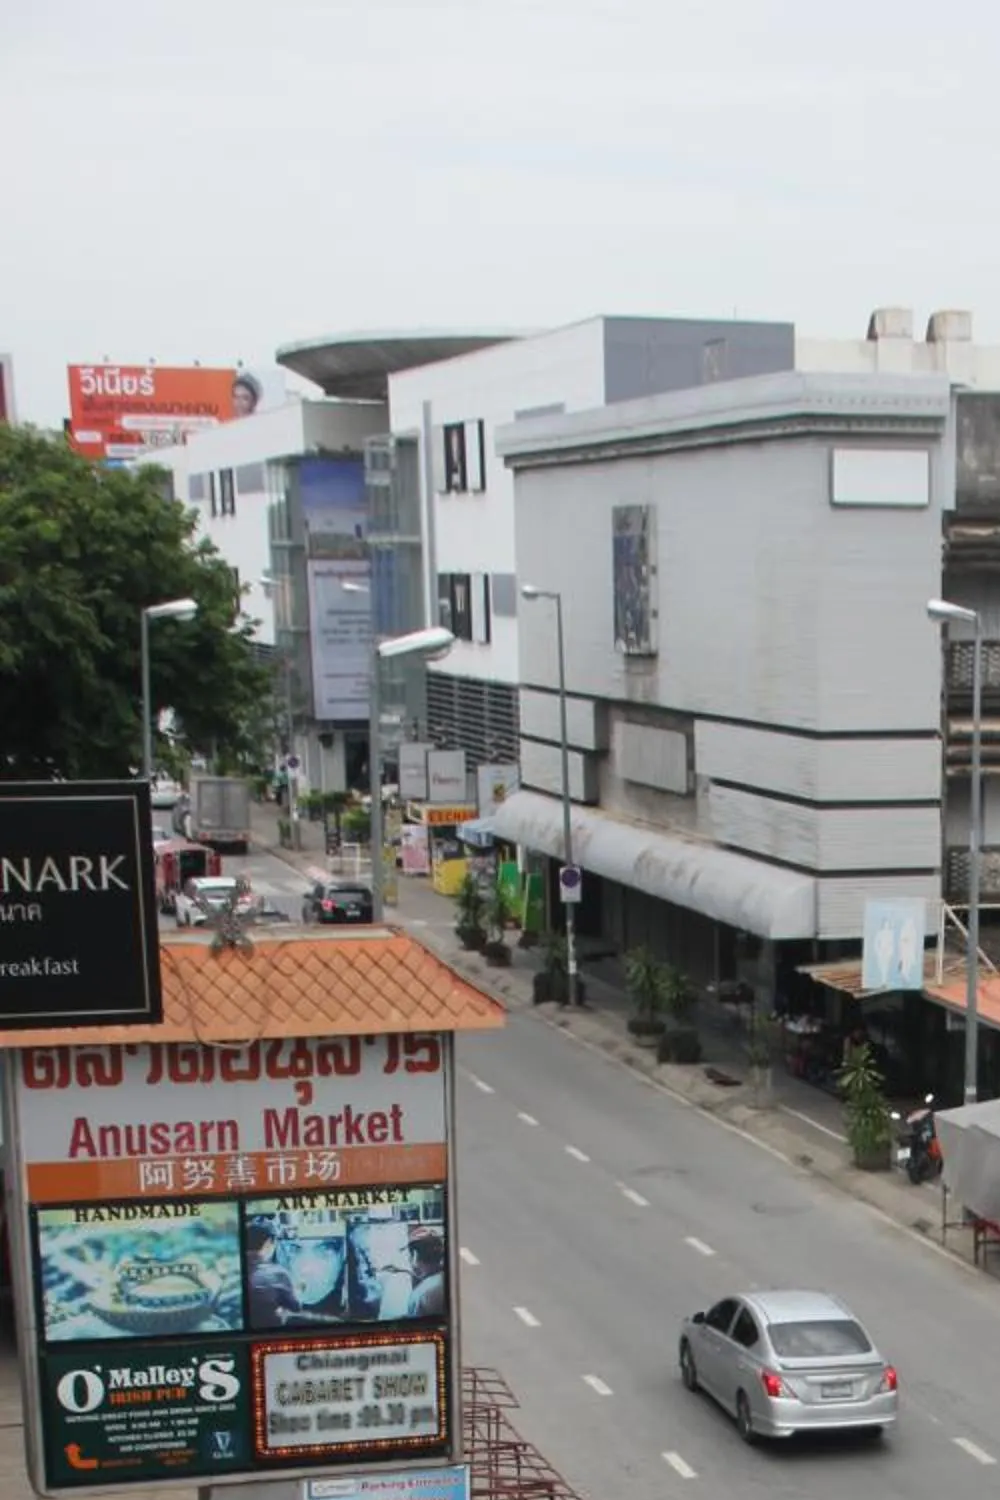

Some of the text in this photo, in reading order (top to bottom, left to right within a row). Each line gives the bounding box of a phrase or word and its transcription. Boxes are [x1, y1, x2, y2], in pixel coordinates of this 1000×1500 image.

[0, 855, 130, 893] NARK
[68, 1104, 404, 1159] Anusarn Market
[139, 1151, 341, 1191] 阿努善市场
[74, 1203, 201, 1223] HANDMADE
[276, 1188, 411, 1211] ART MARKET
[296, 1350, 409, 1371] Chiangmai
[276, 1372, 428, 1406] CABARET SHOW
